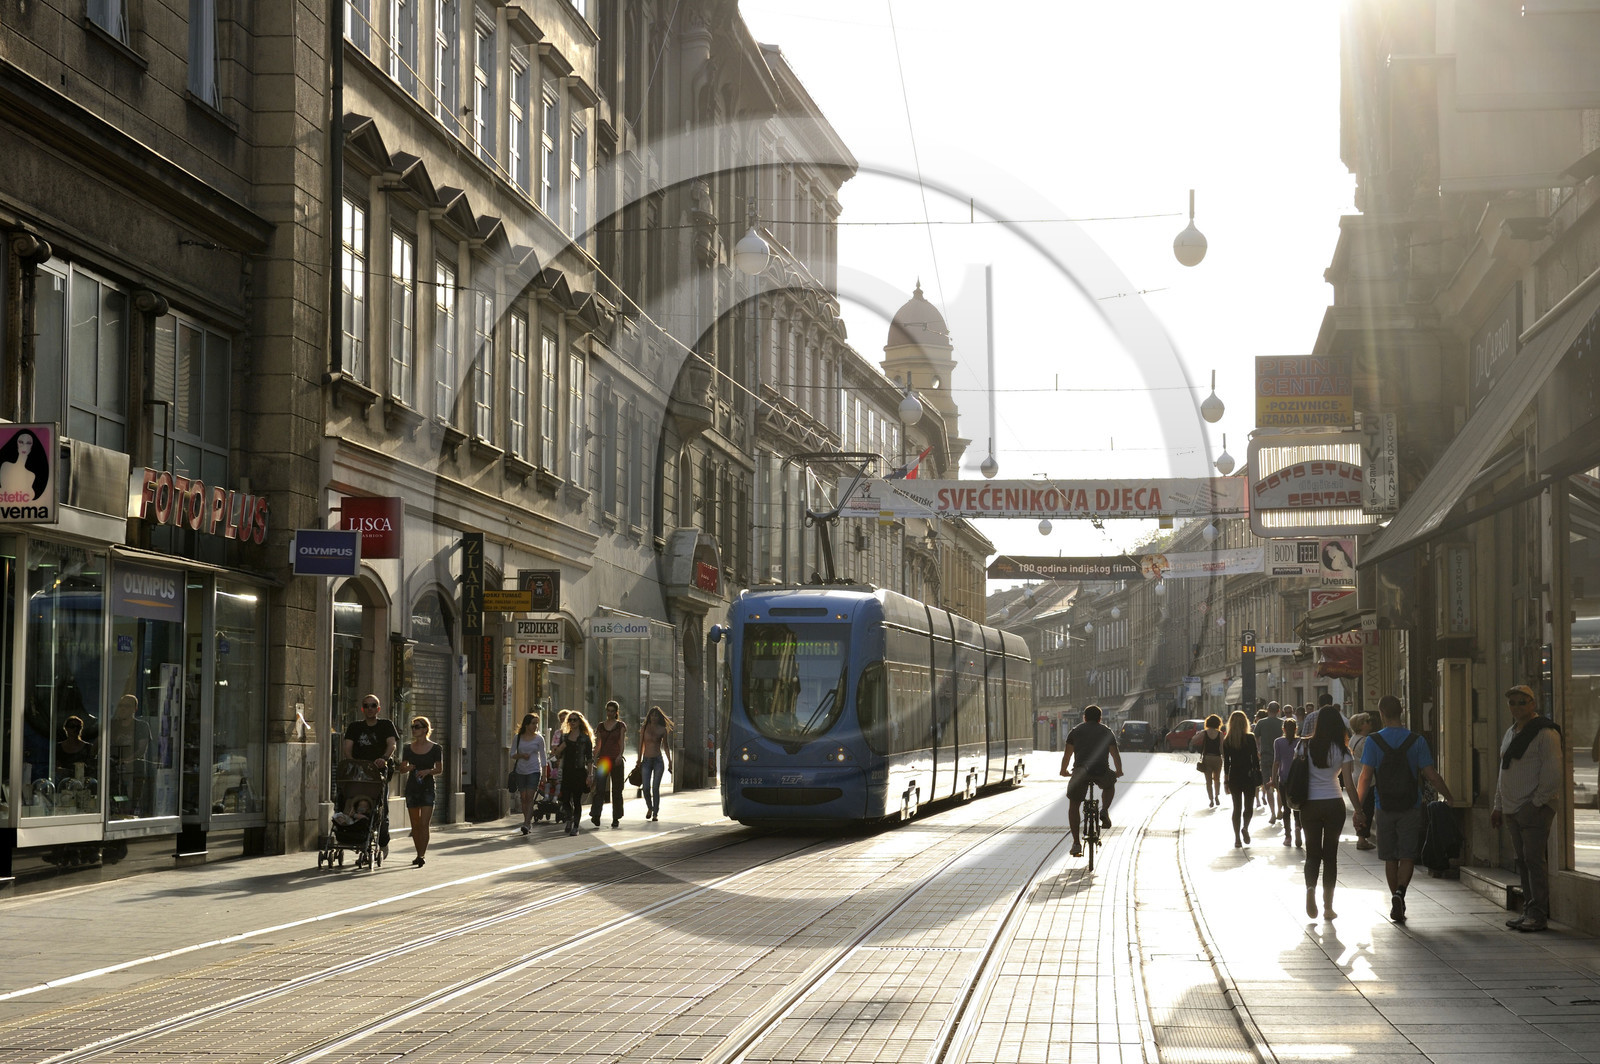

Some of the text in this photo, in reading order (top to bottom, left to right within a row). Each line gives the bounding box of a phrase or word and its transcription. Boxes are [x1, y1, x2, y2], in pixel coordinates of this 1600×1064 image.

[1258, 359, 1352, 375] PRINT
[1259, 377, 1351, 395] CENTAR
[1270, 400, 1339, 410] POZIVNICE
[1262, 413, 1346, 425] IZRADA NATPISA
[1363, 415, 1381, 463] RTV
[1386, 413, 1396, 505] FOTOKOPIRANJE
[1255, 464, 1306, 497] FOTO
[1299, 478, 1344, 491] digital
[1369, 463, 1377, 505] SERVIS
[937, 483, 1088, 511] SVEĆENIKOVA
[1096, 488, 1162, 511] DJECA
[1288, 491, 1361, 506] CENTAR
[140, 466, 267, 544] FOTO PLUS
[349, 517, 392, 531] LISCA
[299, 546, 353, 556] OLYMPUS
[1274, 544, 1296, 562] BODY
[1018, 564, 1034, 572] 100
[1036, 564, 1067, 574] godina
[1069, 563, 1110, 575] indijskog
[1112, 563, 1136, 573] filma
[123, 572, 176, 600] OLYMPUS
[465, 541, 479, 628] ZLATAR
[1321, 577, 1354, 585] Uvema
[517, 622, 559, 634] PEDIKER
[593, 623, 648, 633] naš dom
[1323, 632, 1372, 645] HRAST
[519, 644, 558, 655] CIPELE
[1242, 645, 1255, 653] 311
[1260, 645, 1290, 653] Tuškanac
[483, 636, 491, 694] PEDIKER
[740, 777, 763, 785] 22132
